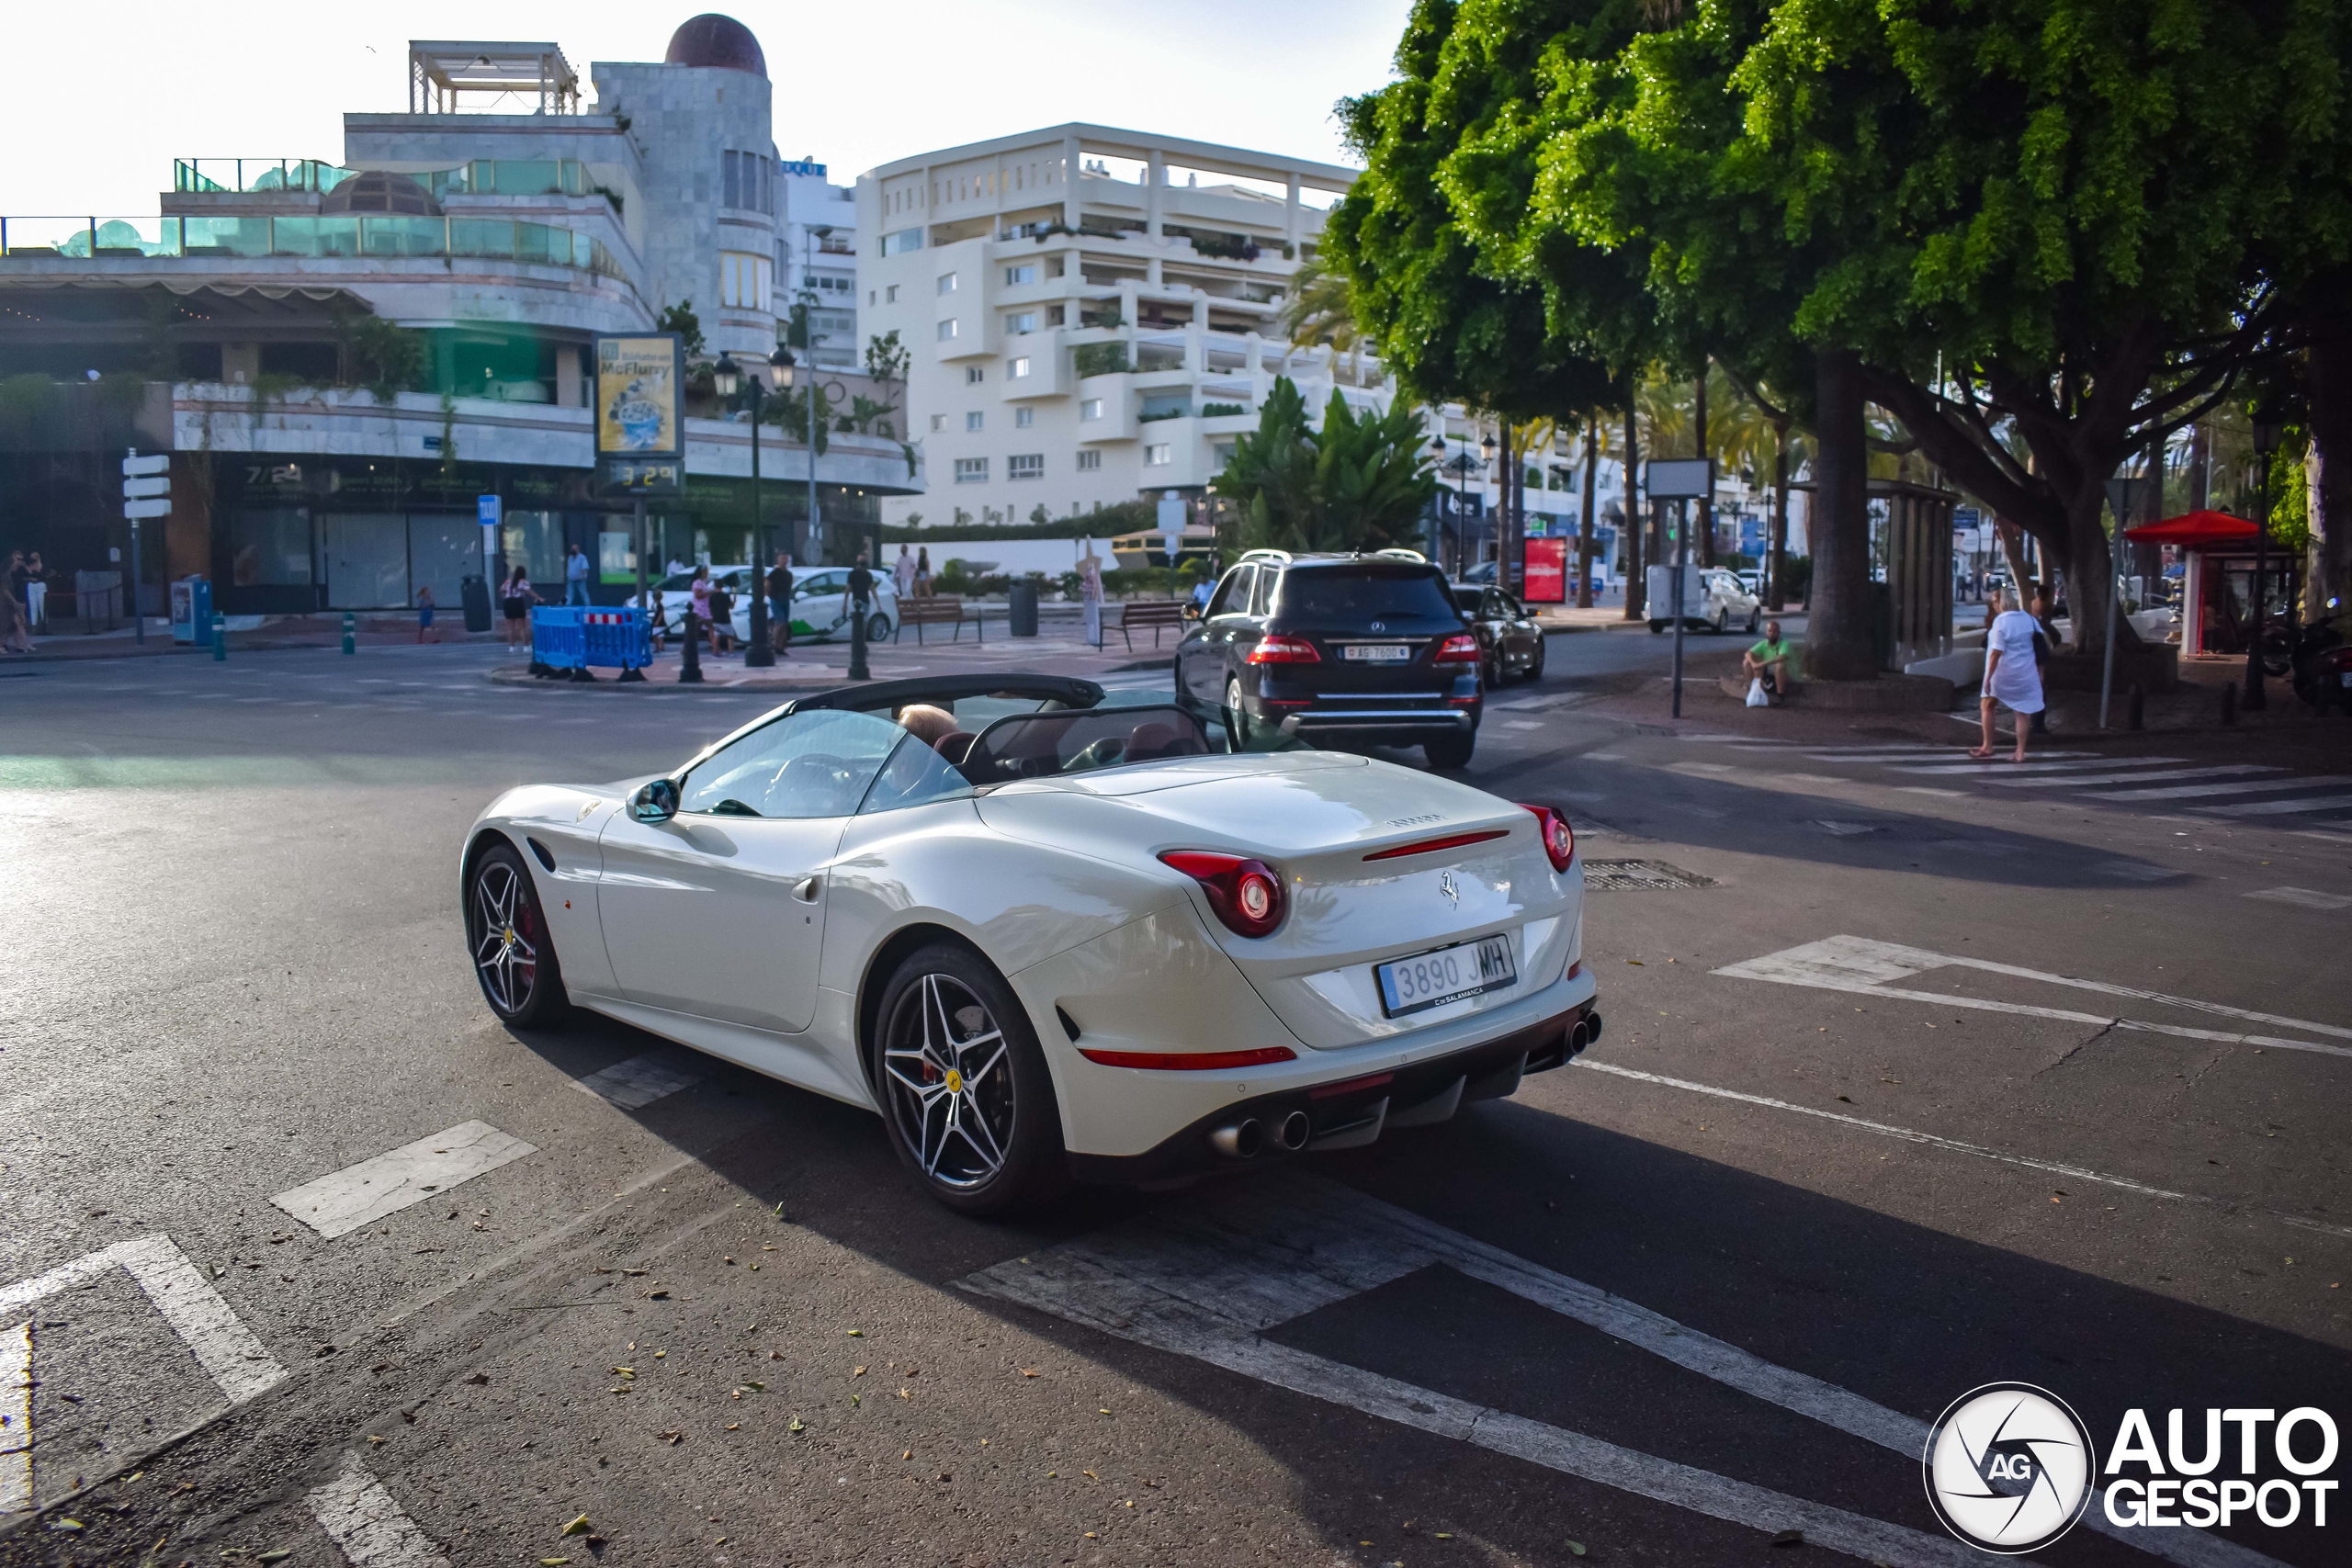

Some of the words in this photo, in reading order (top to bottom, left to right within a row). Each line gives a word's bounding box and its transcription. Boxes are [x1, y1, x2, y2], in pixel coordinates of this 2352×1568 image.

[783, 162, 825, 176] UQUE
[601, 362, 671, 378] McFlurry
[1374, 648, 1396, 658] 7600
[1398, 955, 1459, 998] 3890
[1469, 942, 1507, 982] JMH
[1445, 987, 1484, 1002] SALAMANCA
